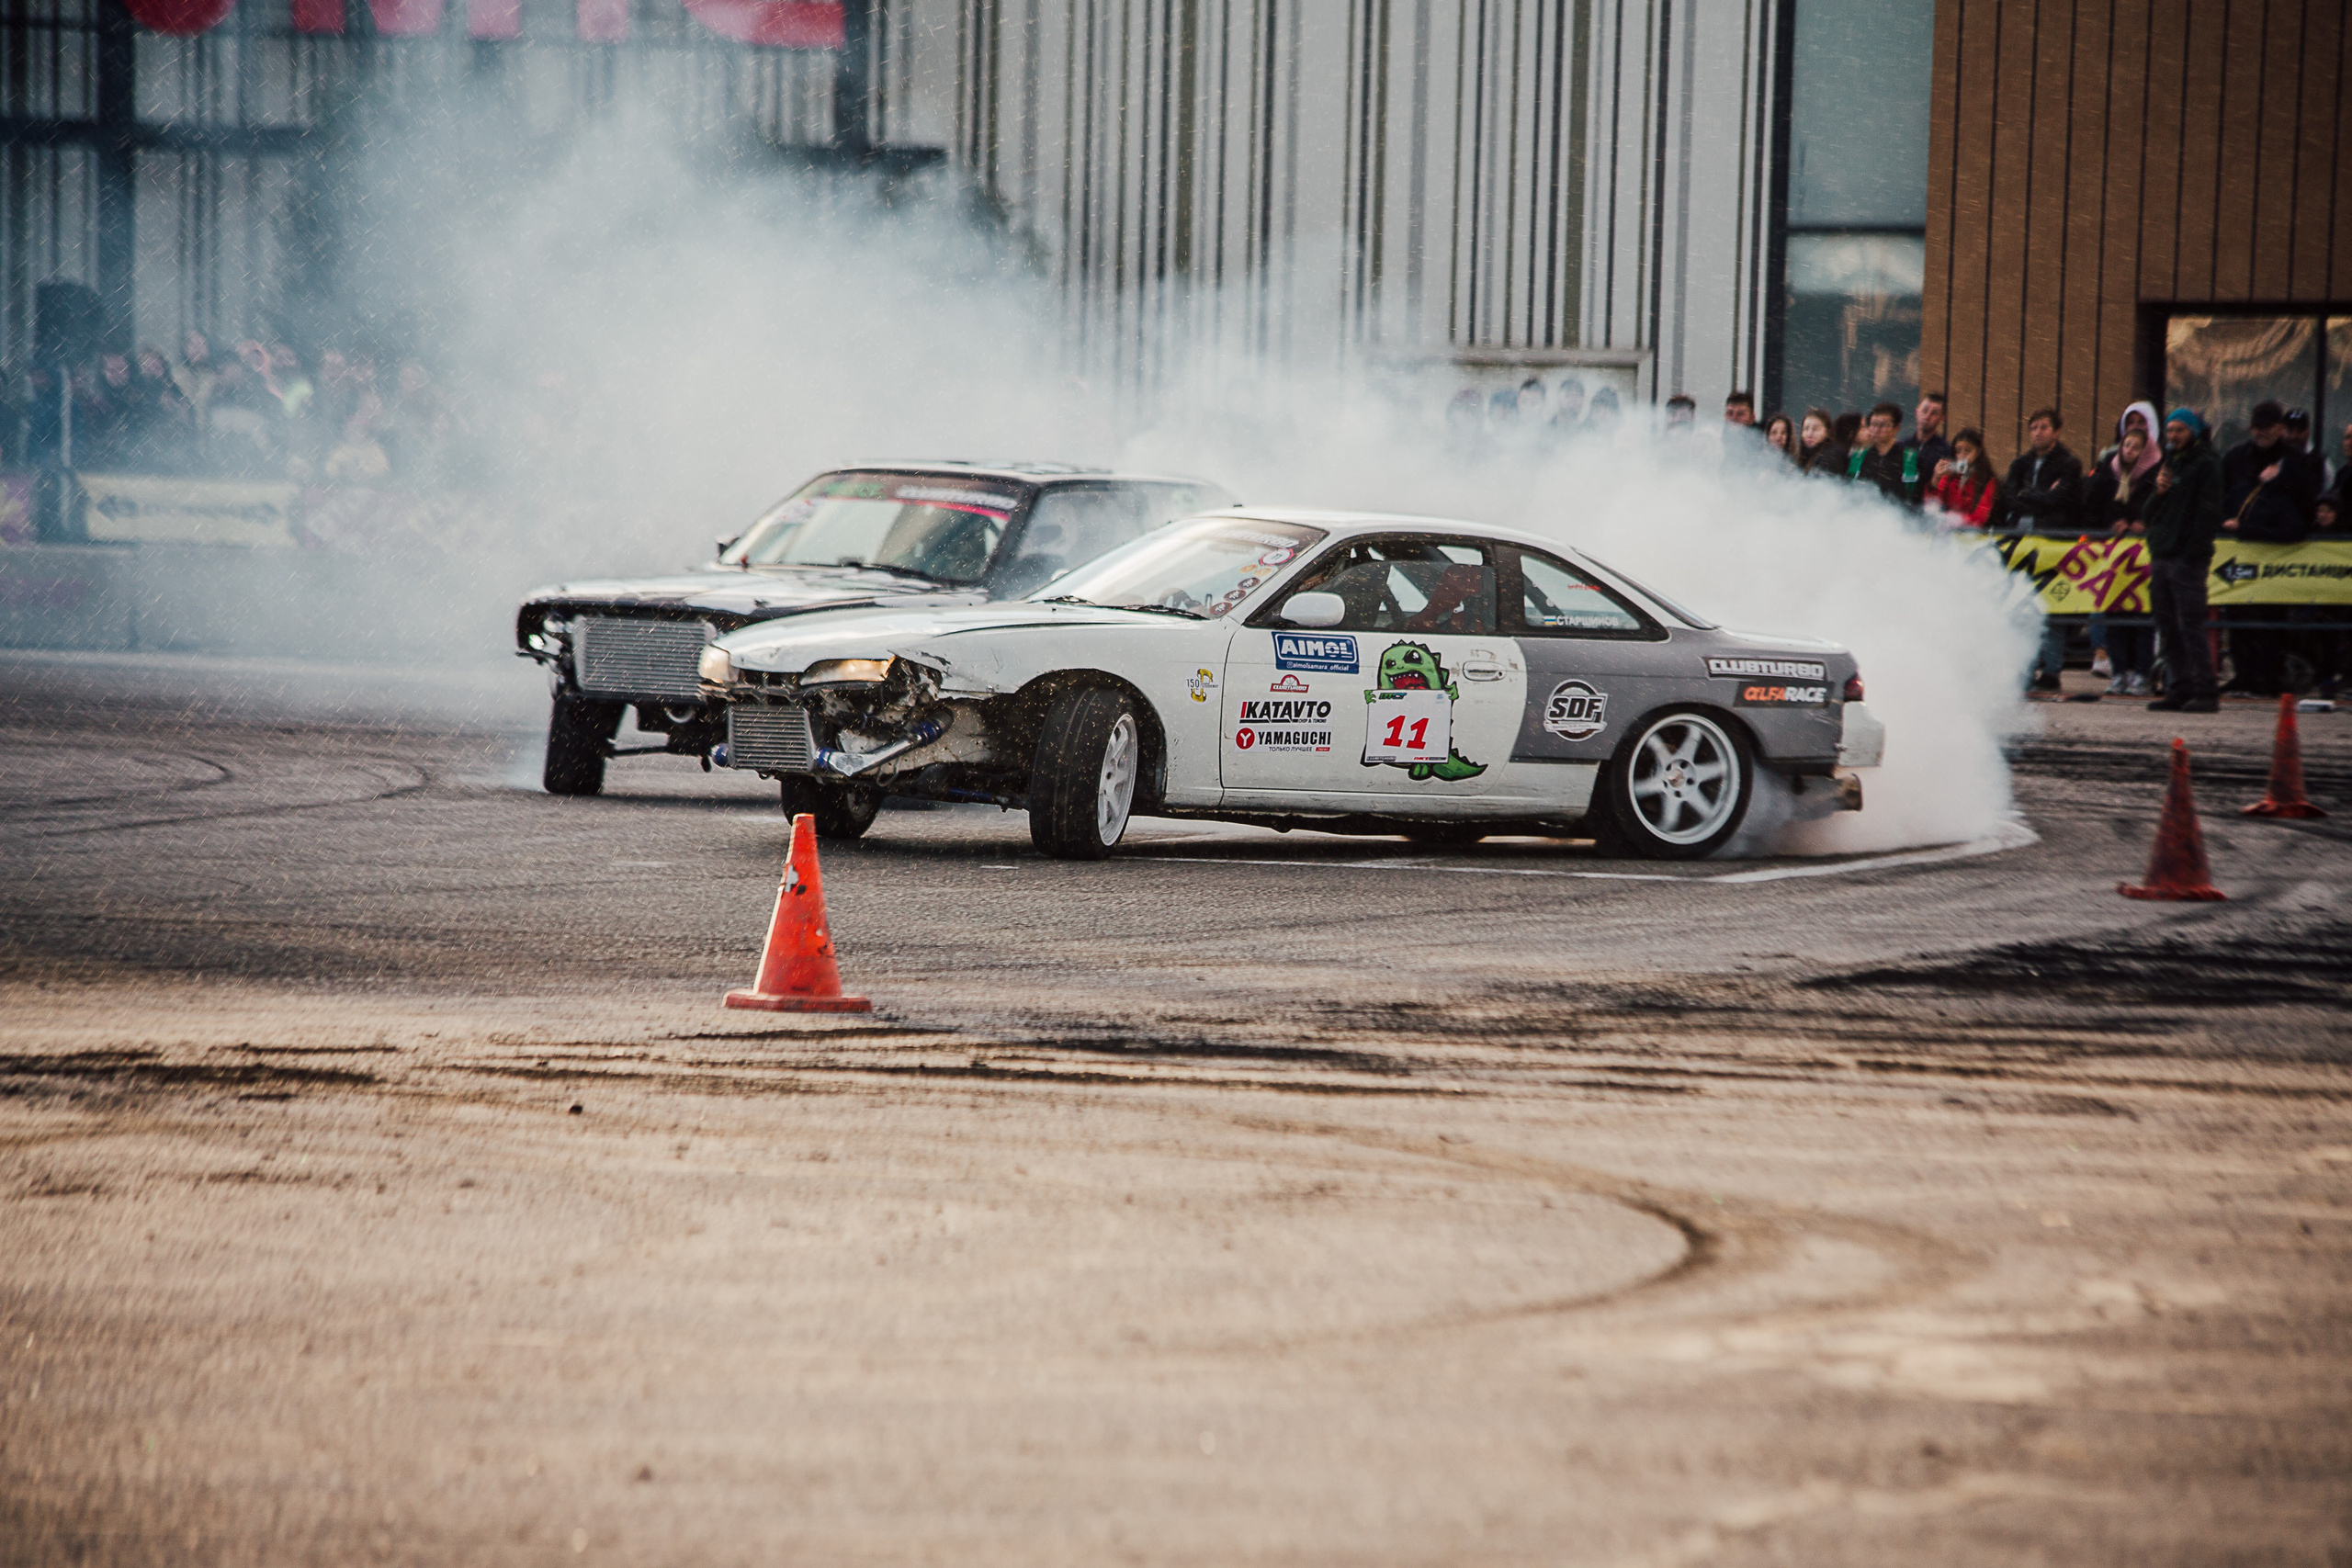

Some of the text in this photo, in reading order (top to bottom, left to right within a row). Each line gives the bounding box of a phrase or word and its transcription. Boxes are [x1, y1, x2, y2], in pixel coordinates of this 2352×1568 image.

[1281, 639, 1352, 658] AIMOL
[1707, 659, 1825, 679] CLUBTURBO
[1186, 679, 1200, 688] 150
[1548, 696, 1604, 719] SDF
[1258, 731, 1331, 745] YAMAGUCHI
[1383, 715, 1430, 750] 11
